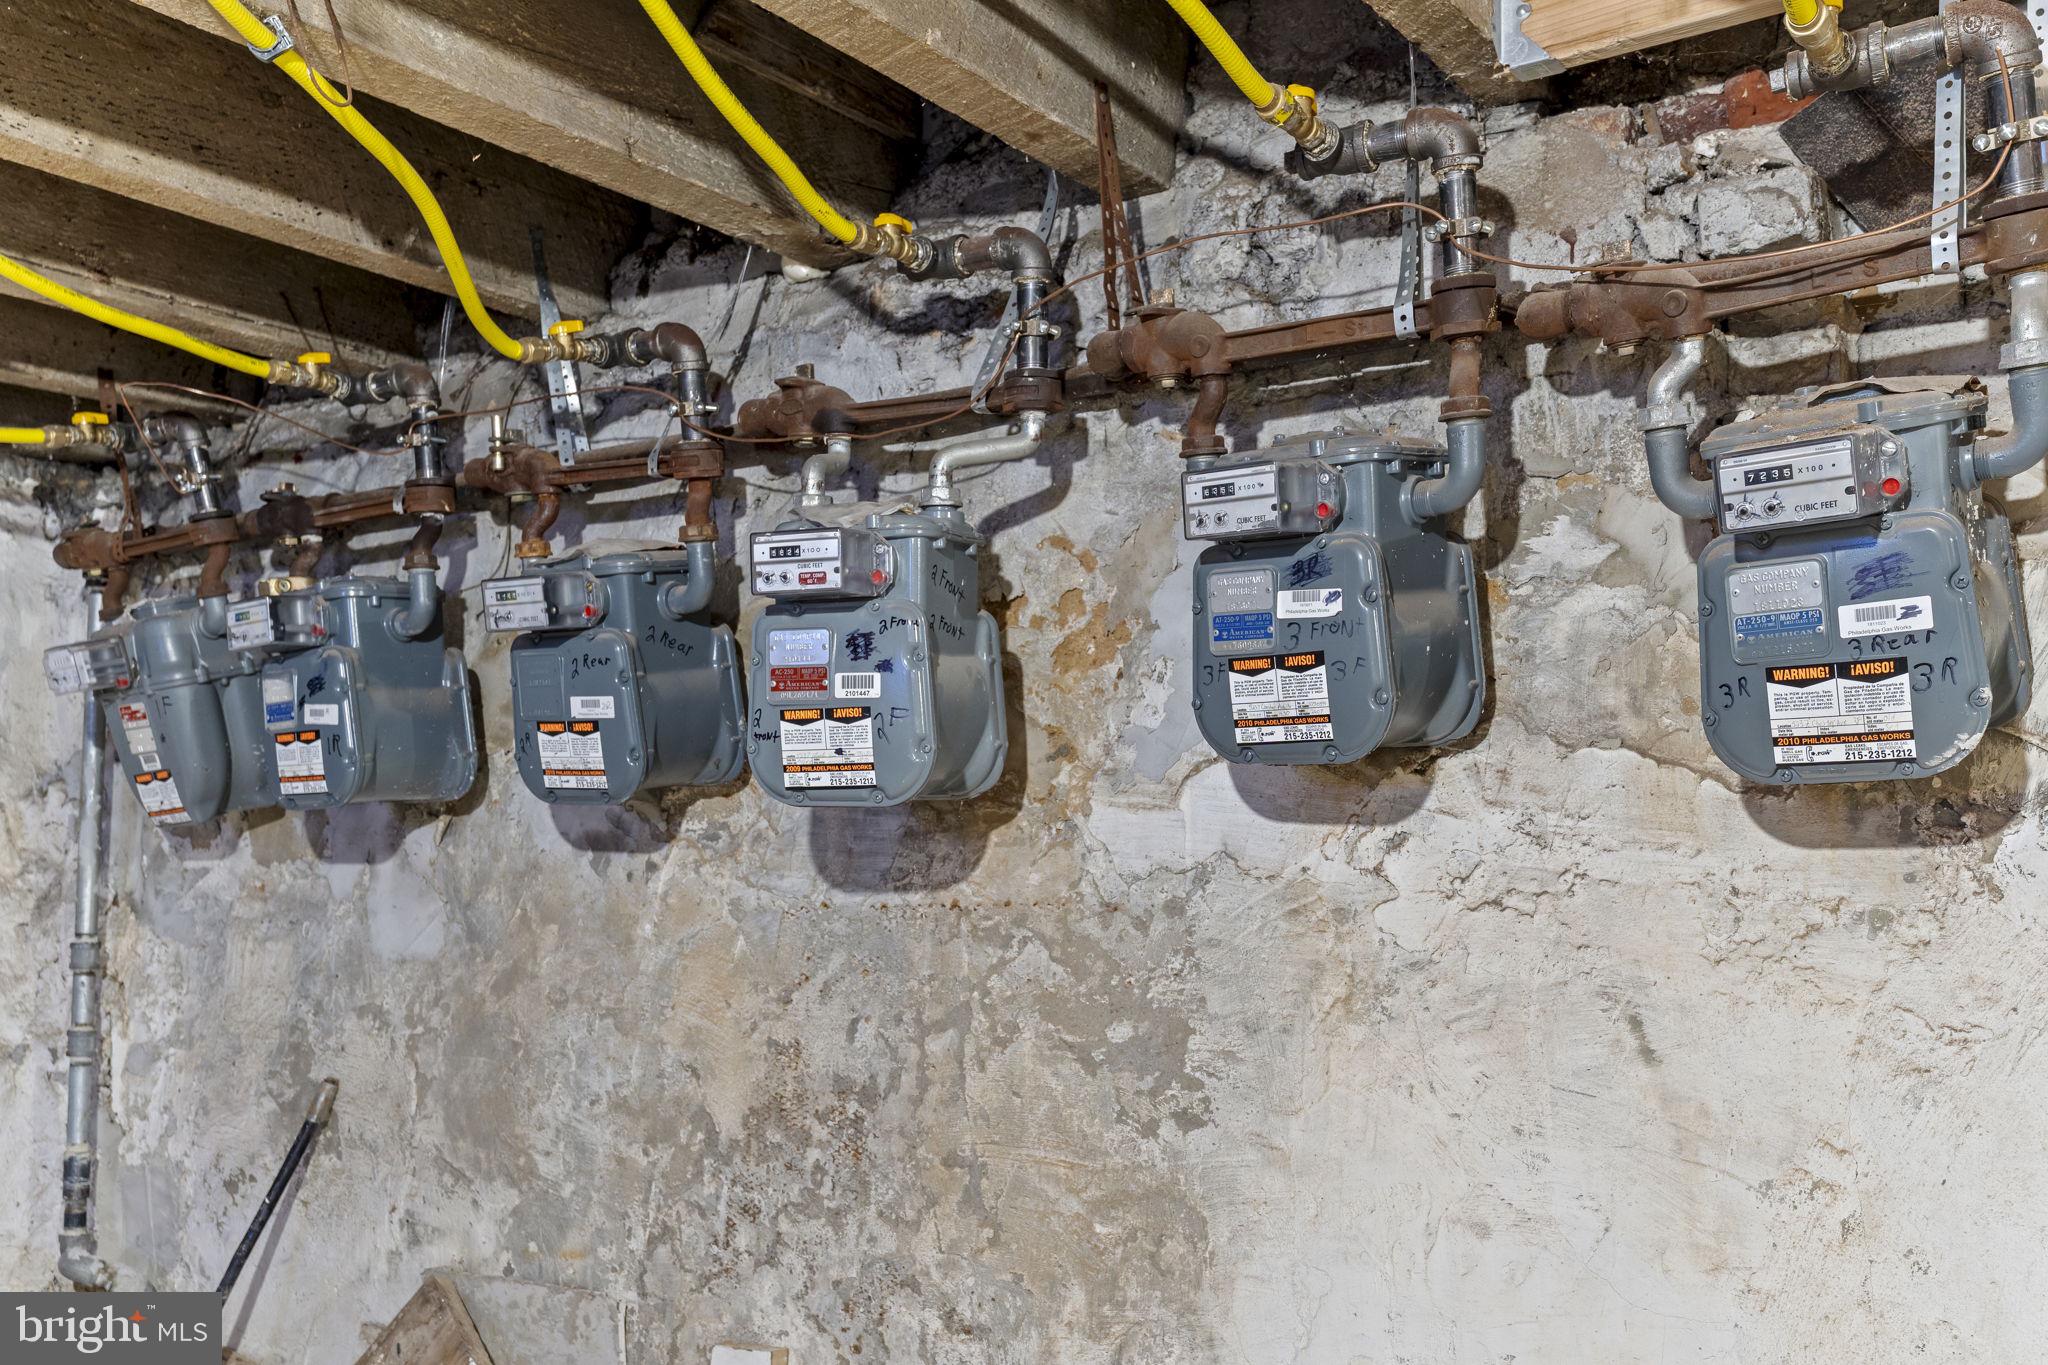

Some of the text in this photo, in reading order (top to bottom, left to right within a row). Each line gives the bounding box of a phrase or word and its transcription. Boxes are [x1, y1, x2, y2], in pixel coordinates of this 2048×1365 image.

[1747, 467, 1792, 483] 7235
[1795, 500, 1838, 513] CUBIC FEET
[1740, 566, 1809, 584] GAS COMPANY
[1754, 580, 1798, 595] NUMBER
[1737, 614, 1776, 626] AT-250-9
[1780, 612, 1800, 621] MAOP
[879, 619, 888, 635] 2
[1848, 628, 1880, 638] Philadelphia
[645, 625, 693, 657] 2 Rear
[1283, 622, 1301, 650] 3
[1848, 630, 1938, 660] 3 Rear
[572, 654, 610, 680] 2 Rear
[1233, 655, 1315, 670] WARNING! ¡AVISO!
[1773, 661, 1894, 681] WARNING! ¡AVISO!
[753, 708, 762, 728] 2
[784, 708, 862, 719] WARNING! ¡AVISO!
[1284, 731, 1331, 740] 215-235-1212
[1778, 737, 1800, 746] 2010
[1802, 735, 1859, 744] PHILADELPHIA
[1879, 732, 1910, 740] WORKS
[1845, 749, 1912, 760] 215-235-1212
[830, 778, 874, 788] 215-235-1212
